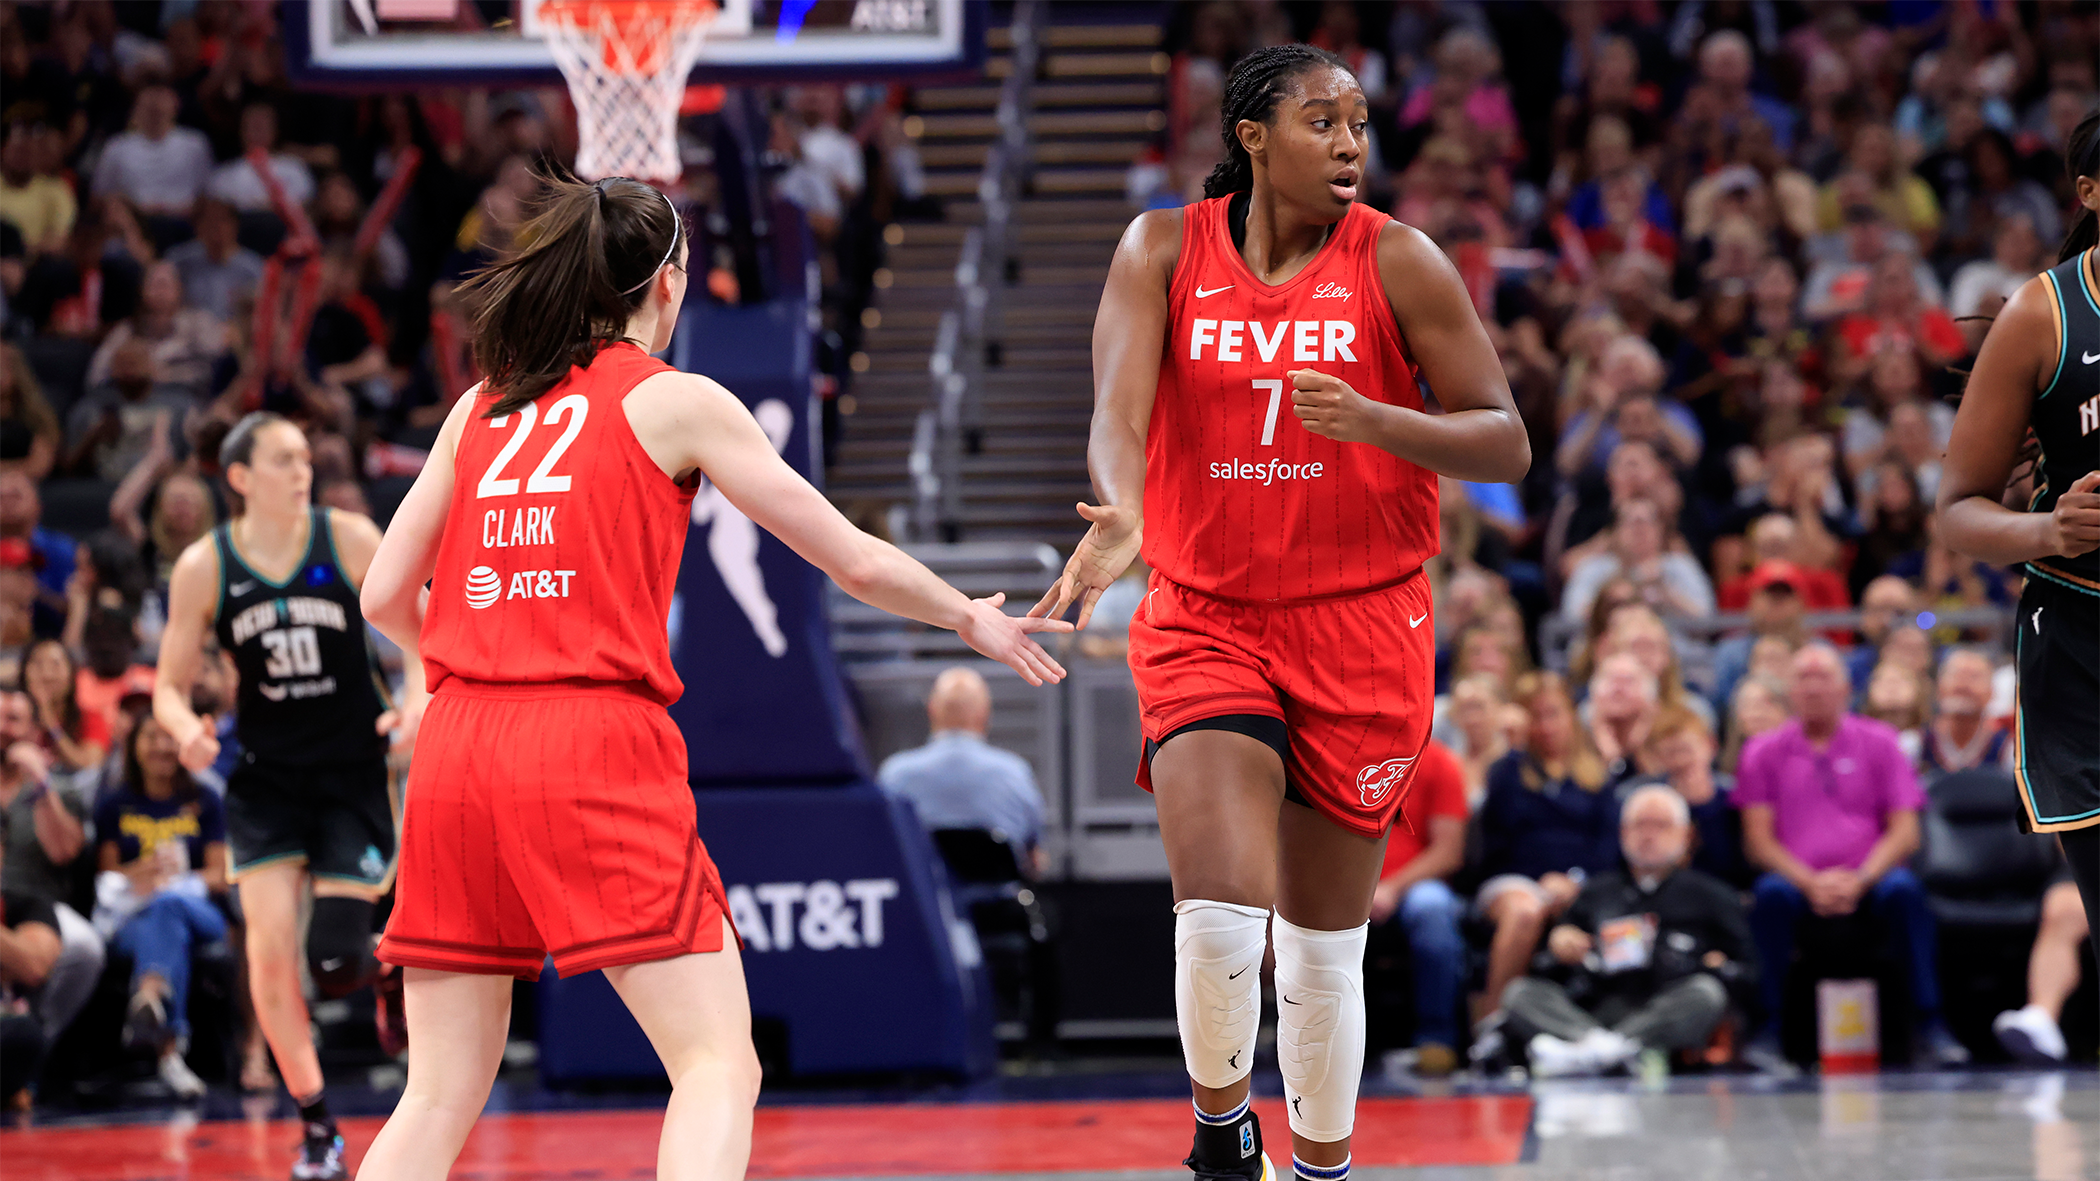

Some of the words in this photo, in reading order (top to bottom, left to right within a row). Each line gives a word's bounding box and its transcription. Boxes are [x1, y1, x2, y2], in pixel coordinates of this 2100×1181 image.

[1312, 281, 1353, 302] Lilly
[1189, 318, 1358, 363] FEVER
[1251, 378, 1283, 446] 7
[2078, 394, 2100, 437] N
[475, 394, 589, 499] 22
[1209, 457, 1324, 486] salesforce
[482, 506, 556, 549] CLARK
[506, 569, 577, 601] AT&T
[260, 625, 322, 679] 30
[727, 877, 899, 952] AT&T
